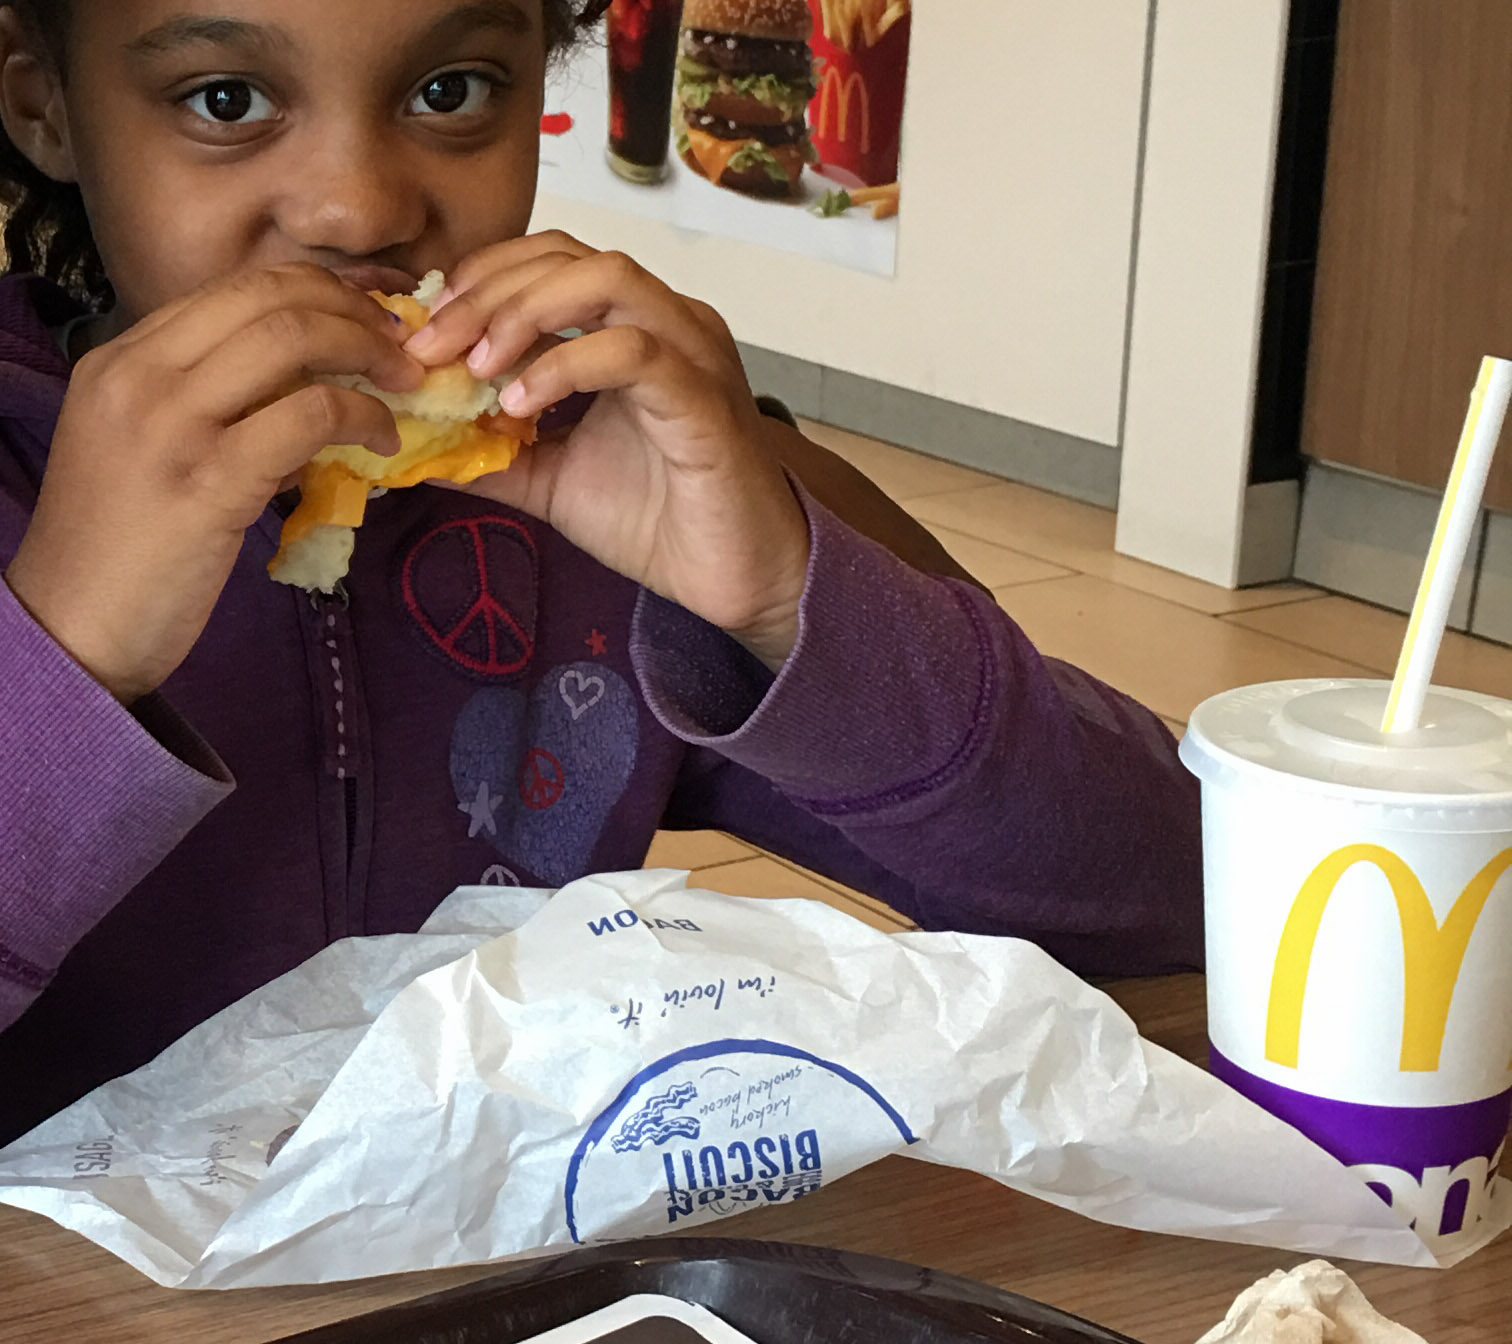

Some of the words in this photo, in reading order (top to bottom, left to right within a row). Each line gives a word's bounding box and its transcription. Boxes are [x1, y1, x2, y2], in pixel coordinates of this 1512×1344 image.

[660, 977, 725, 1018] lovin'
[738, 976, 776, 998] i'm
[698, 1089, 741, 1116] bacon
[747, 1065, 803, 1105] smoked
[730, 1095, 791, 1129] hickory
[663, 1128, 822, 1205] BISCUIT
